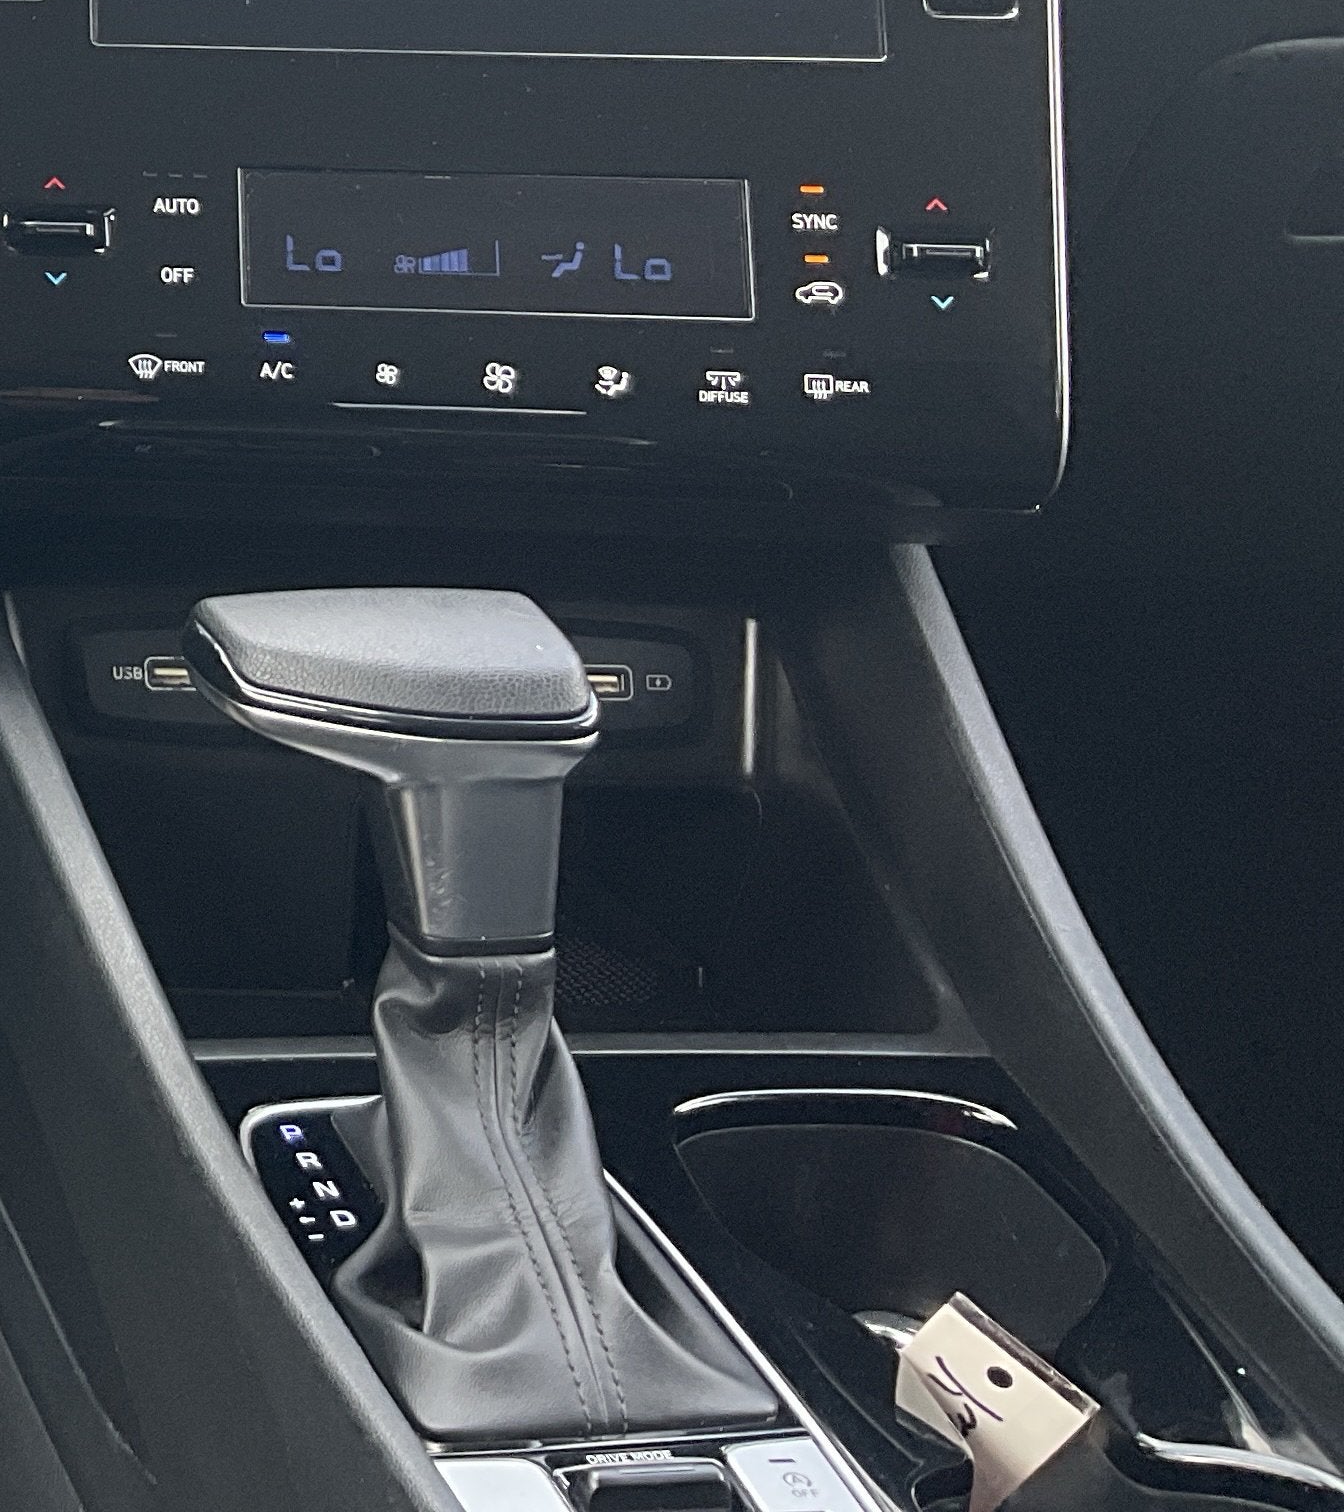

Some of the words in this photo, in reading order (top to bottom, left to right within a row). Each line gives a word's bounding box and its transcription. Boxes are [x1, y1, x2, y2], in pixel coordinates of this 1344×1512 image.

[153, 197, 200, 215] AUTO
[791, 212, 839, 232] SYNC
[160, 266, 195, 285] OFF
[163, 359, 205, 374] FRONT
[259, 362, 295, 380] A/C
[834, 380, 869, 394] REAR
[697, 389, 749, 405] DIFFUSE
[112, 665, 143, 680] USB
[279, 1124, 304, 1141] P
[295, 1151, 323, 1169] R
[312, 1180, 340, 1199] N
[329, 1209, 357, 1228] D
